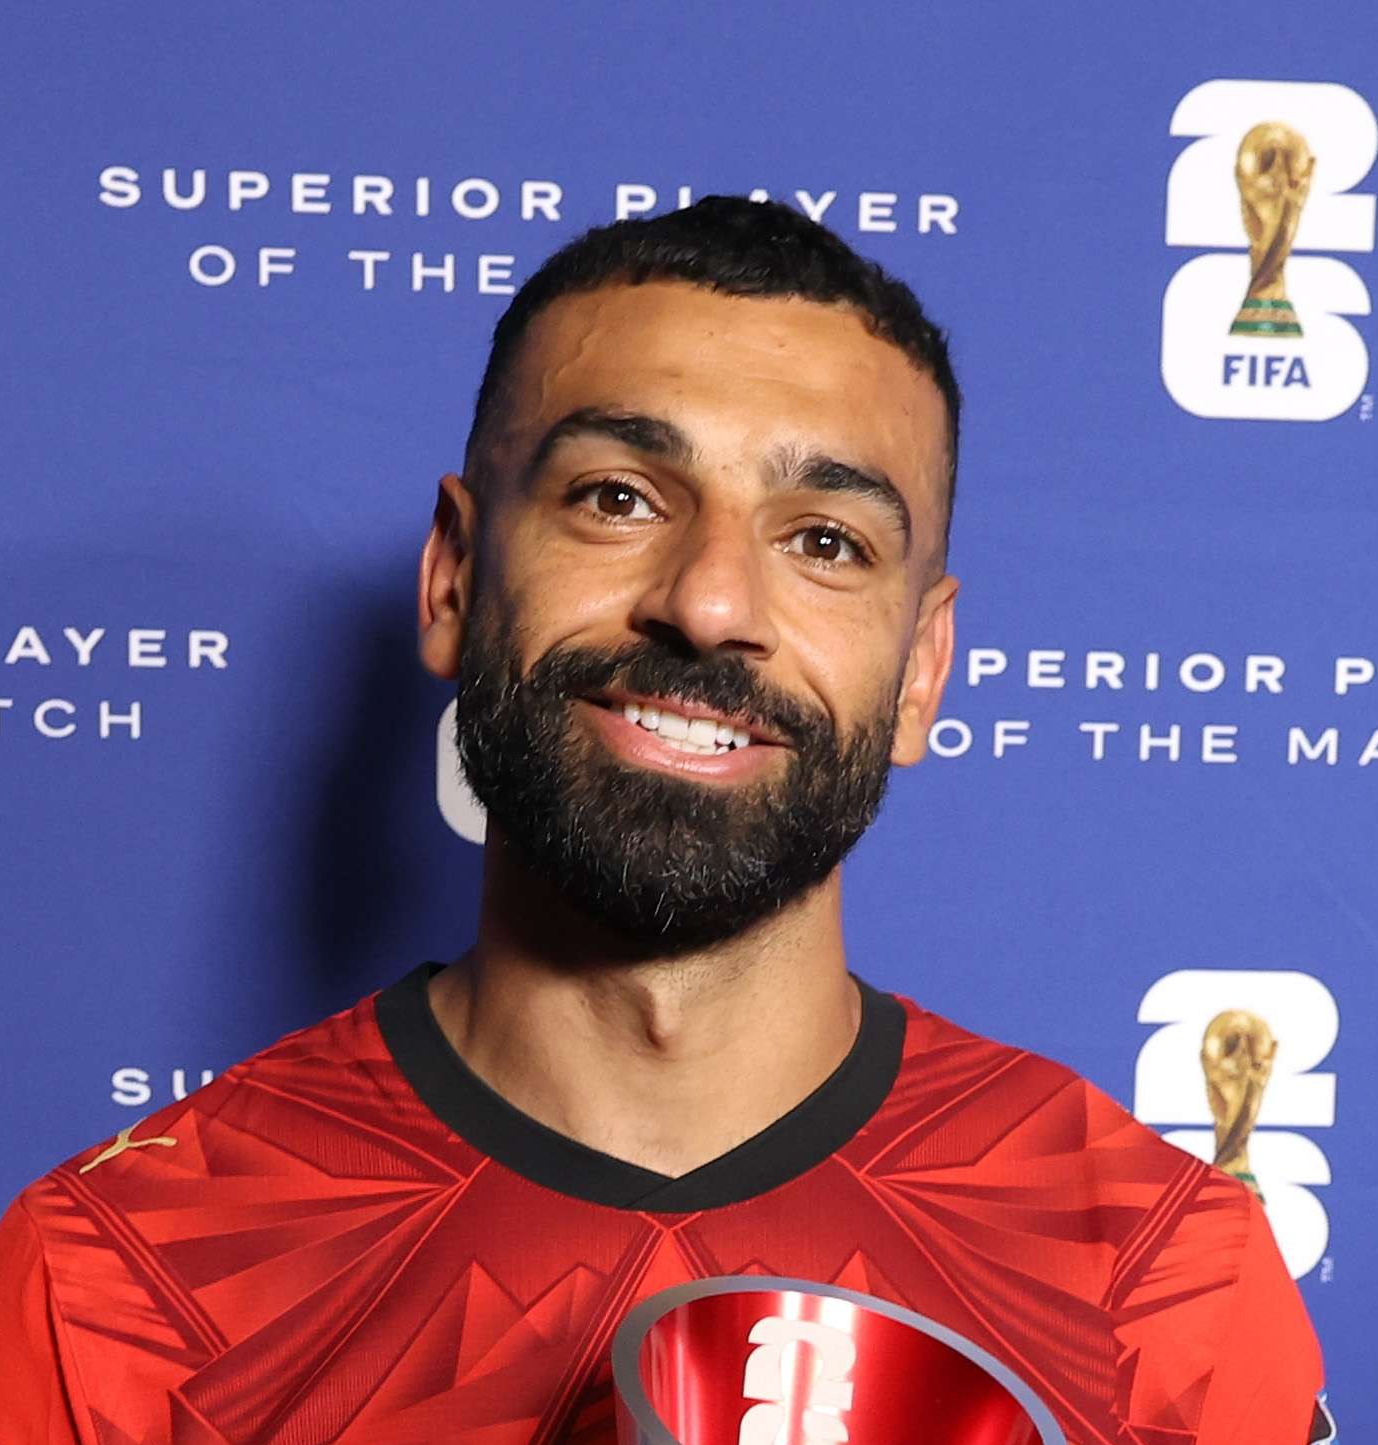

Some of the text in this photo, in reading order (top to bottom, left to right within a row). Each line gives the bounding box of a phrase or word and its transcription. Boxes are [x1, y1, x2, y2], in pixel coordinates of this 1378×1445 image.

[100, 167, 958, 234] SUPERIOR PYER
[190, 246, 514, 294] OF THE
[1223, 354, 1310, 388] FIFA
[968, 648, 1284, 693] PERIOR
[928, 719, 1030, 759] OF
[1080, 723, 1237, 762] THE
